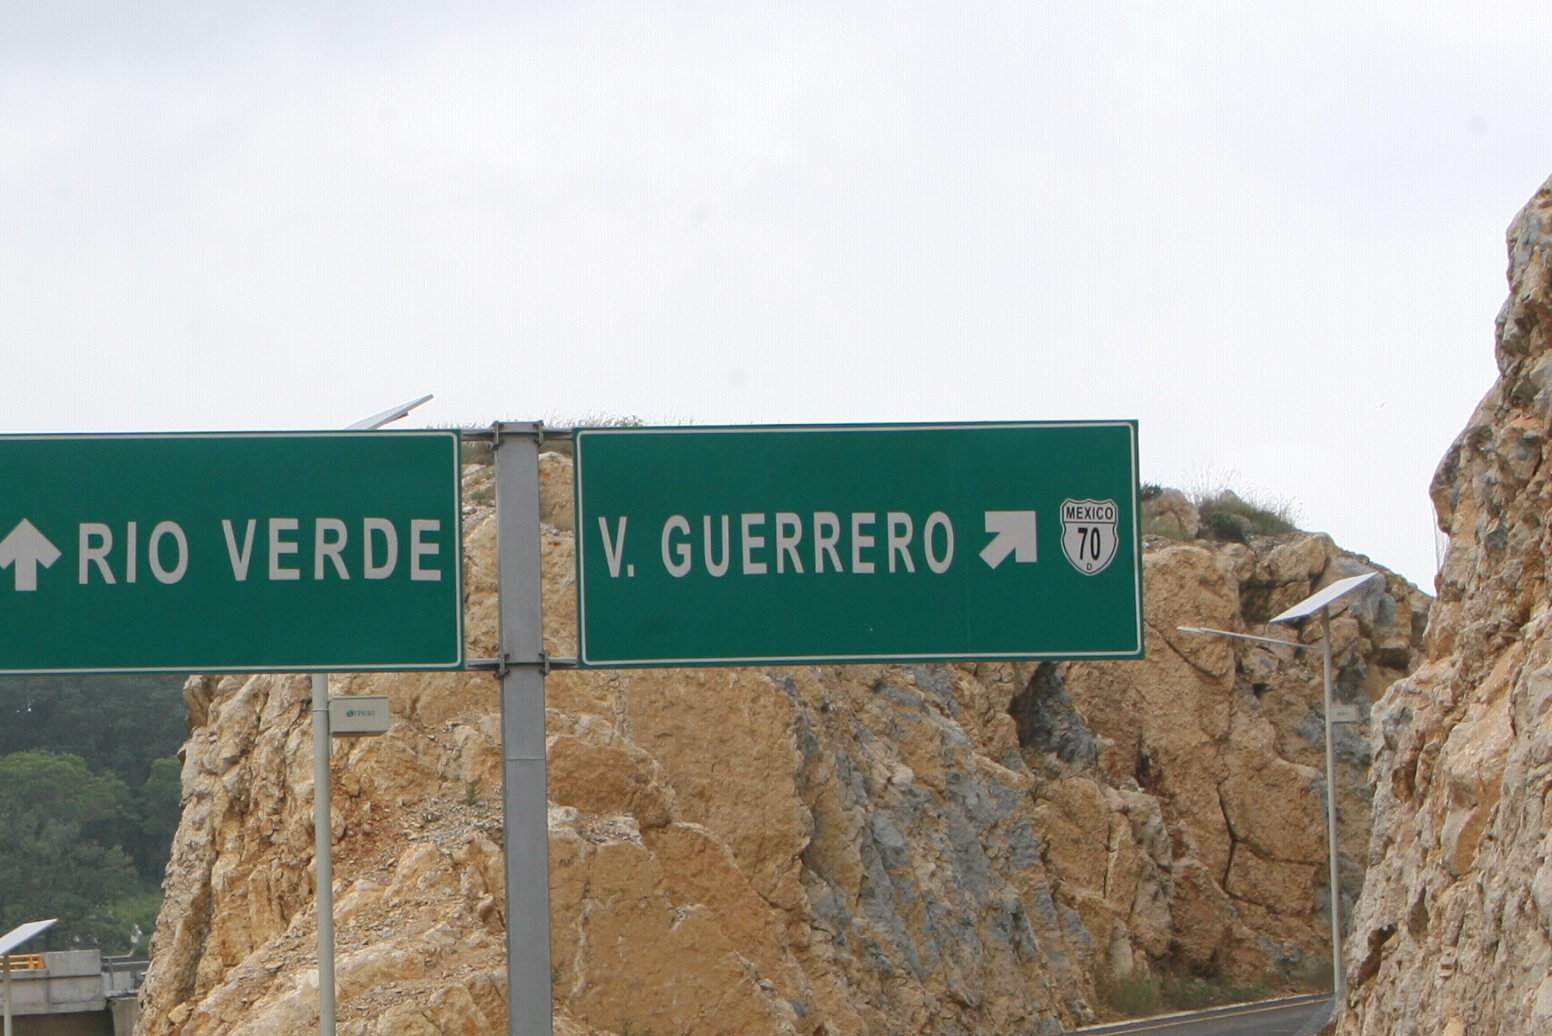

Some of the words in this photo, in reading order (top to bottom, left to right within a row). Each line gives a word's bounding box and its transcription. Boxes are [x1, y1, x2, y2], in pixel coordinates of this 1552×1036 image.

[1066, 506, 1114, 520] MEXICO
[79, 520, 188, 585] RIO
[222, 518, 441, 581] VERDE
[598, 516, 634, 578] V.
[661, 511, 955, 578] GUERRERO
[1077, 527, 1101, 561] 70
